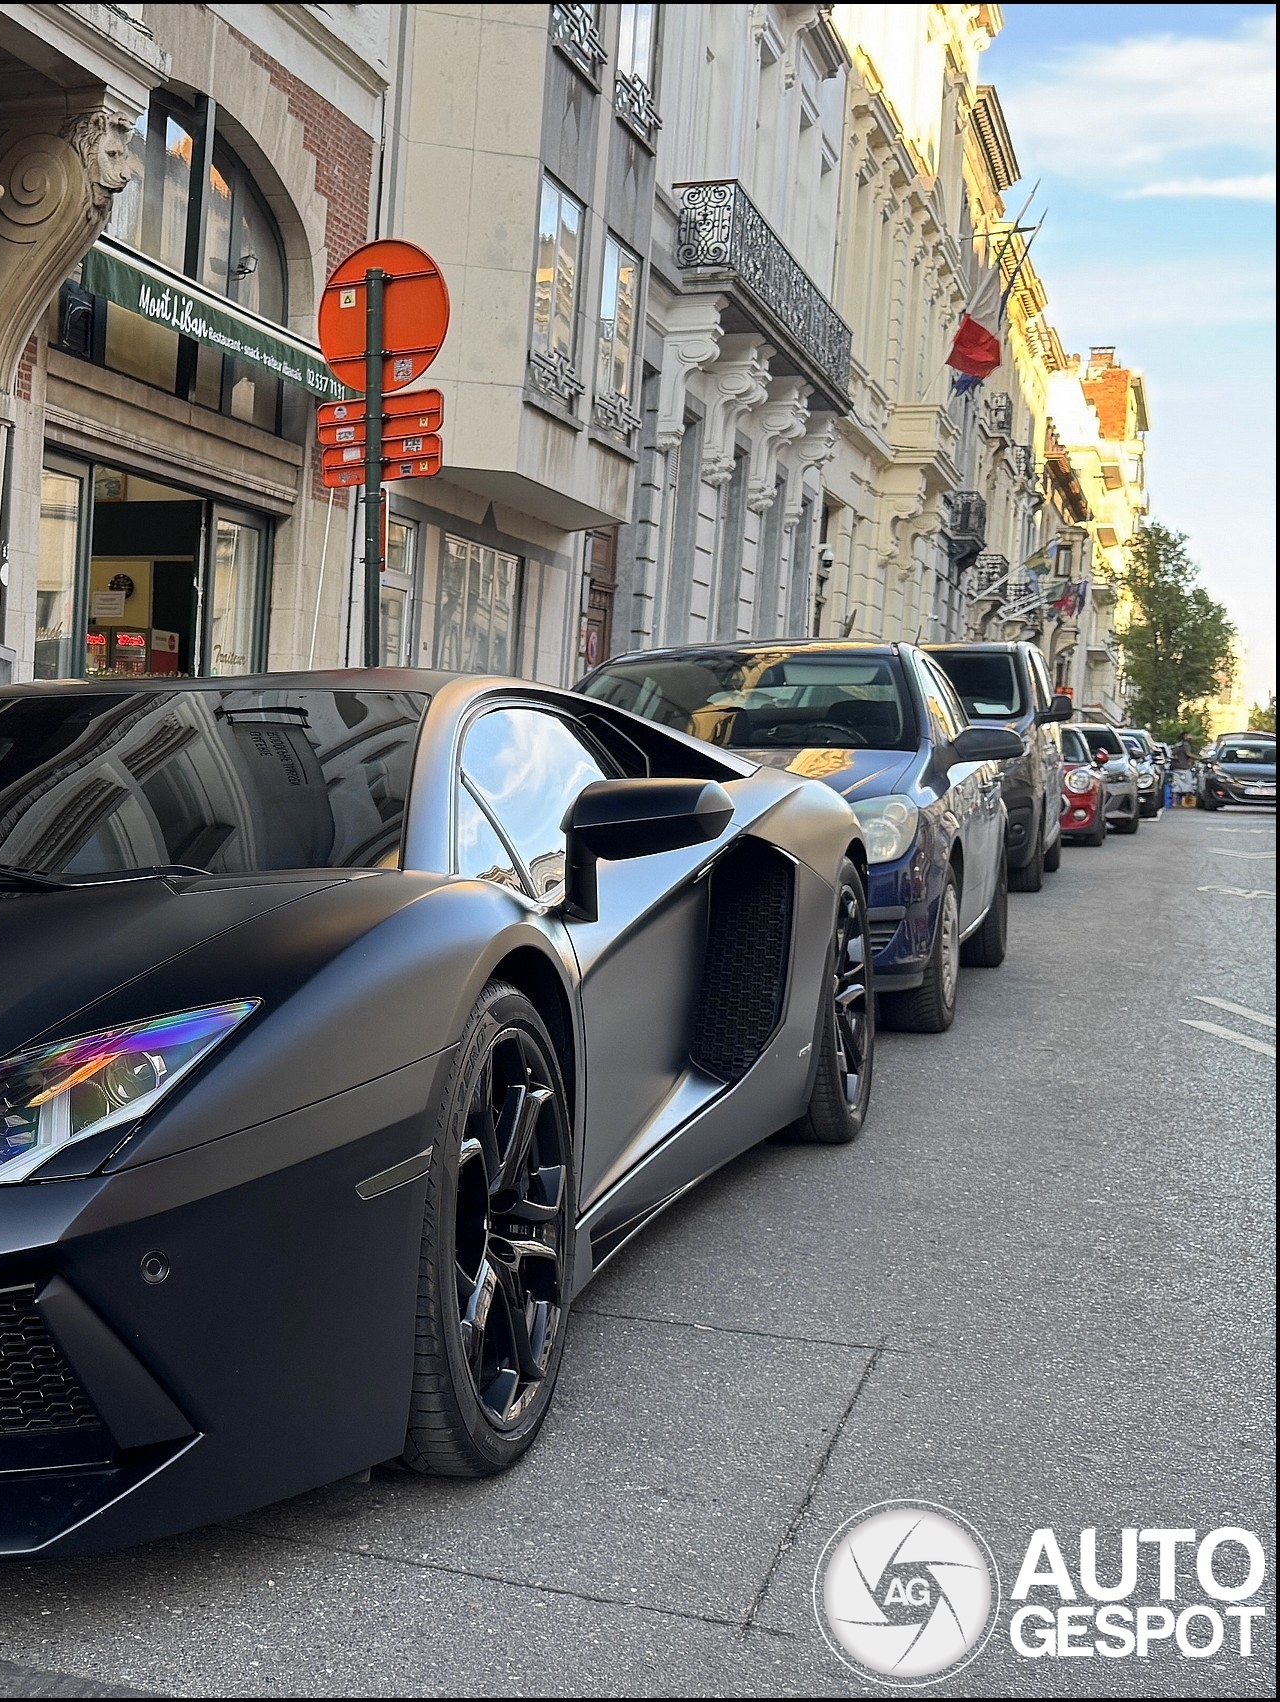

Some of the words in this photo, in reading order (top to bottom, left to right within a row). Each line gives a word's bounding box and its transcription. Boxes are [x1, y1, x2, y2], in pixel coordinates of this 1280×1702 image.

[138, 284, 173, 322] Mont
[171, 294, 209, 339] Liban
[208, 329, 242, 352] Restaurant
